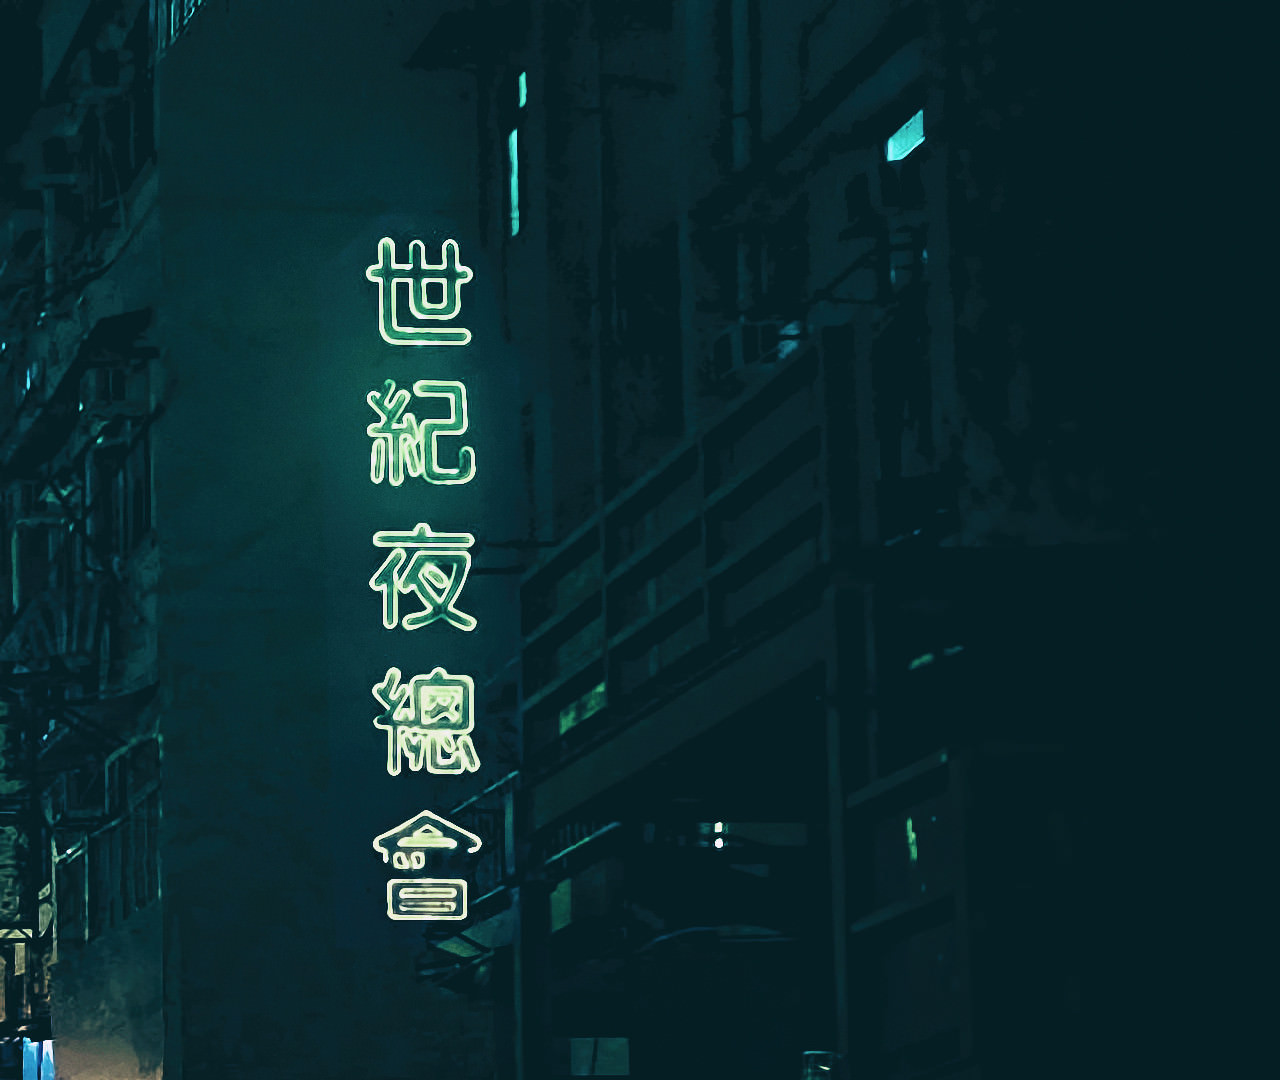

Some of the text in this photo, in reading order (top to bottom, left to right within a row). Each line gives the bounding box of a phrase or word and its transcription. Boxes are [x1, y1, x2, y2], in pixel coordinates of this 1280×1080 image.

[366, 236, 482, 921] 世紀夜總會
